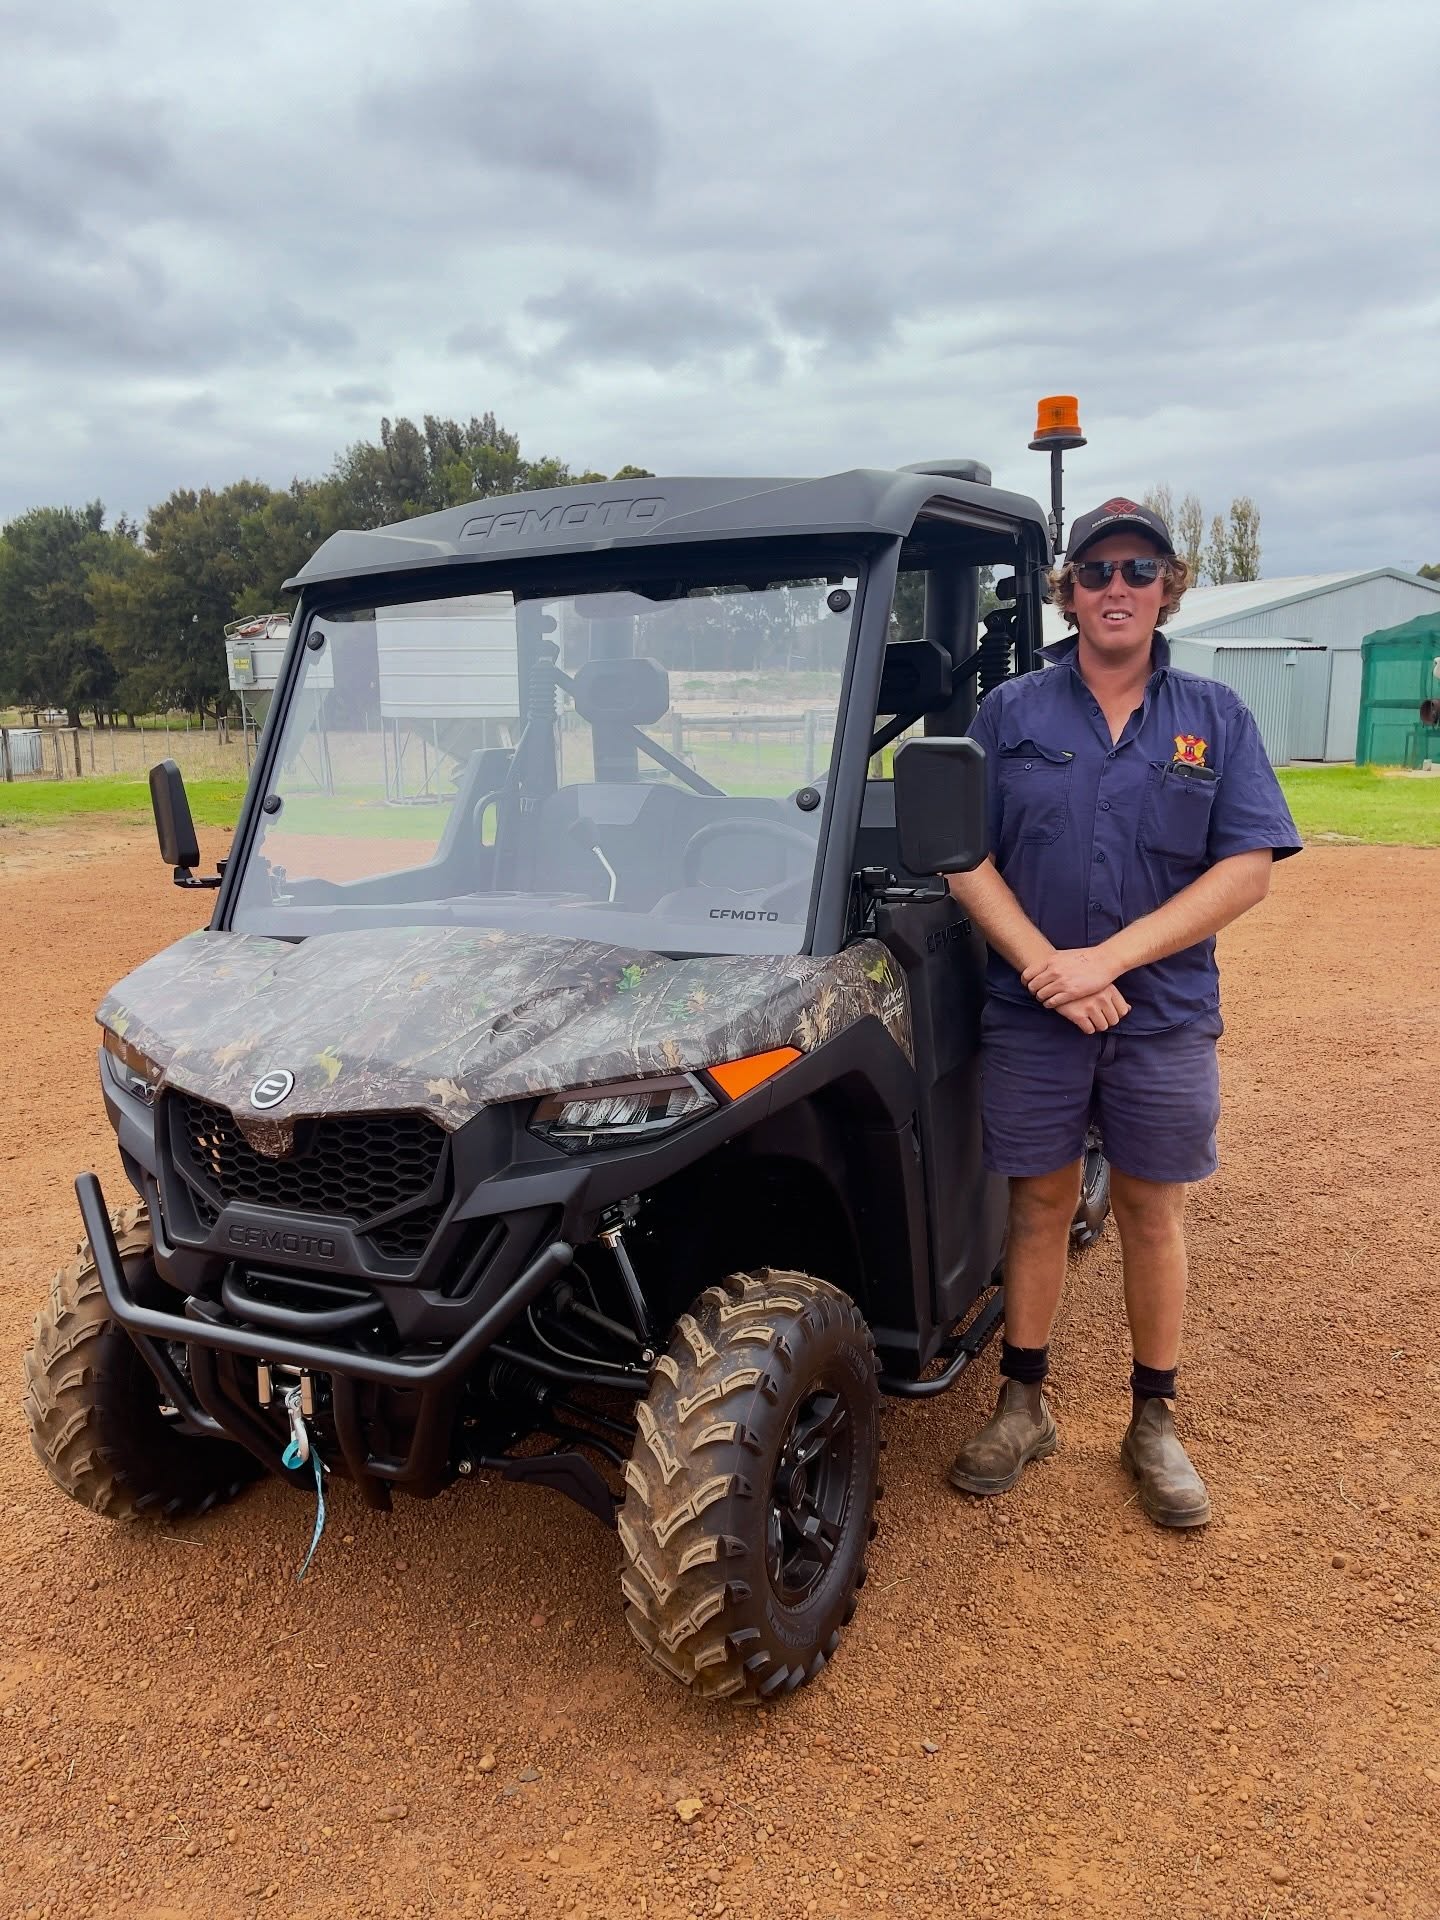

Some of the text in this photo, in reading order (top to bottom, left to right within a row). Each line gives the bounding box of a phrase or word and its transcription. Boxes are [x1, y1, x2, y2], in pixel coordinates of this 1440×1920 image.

[459, 496, 666, 542] CFMOTO
[709, 909, 779, 921] CFMOTO
[883, 1001, 904, 1025] EPS
[229, 1224, 336, 1259] CFMOTO
